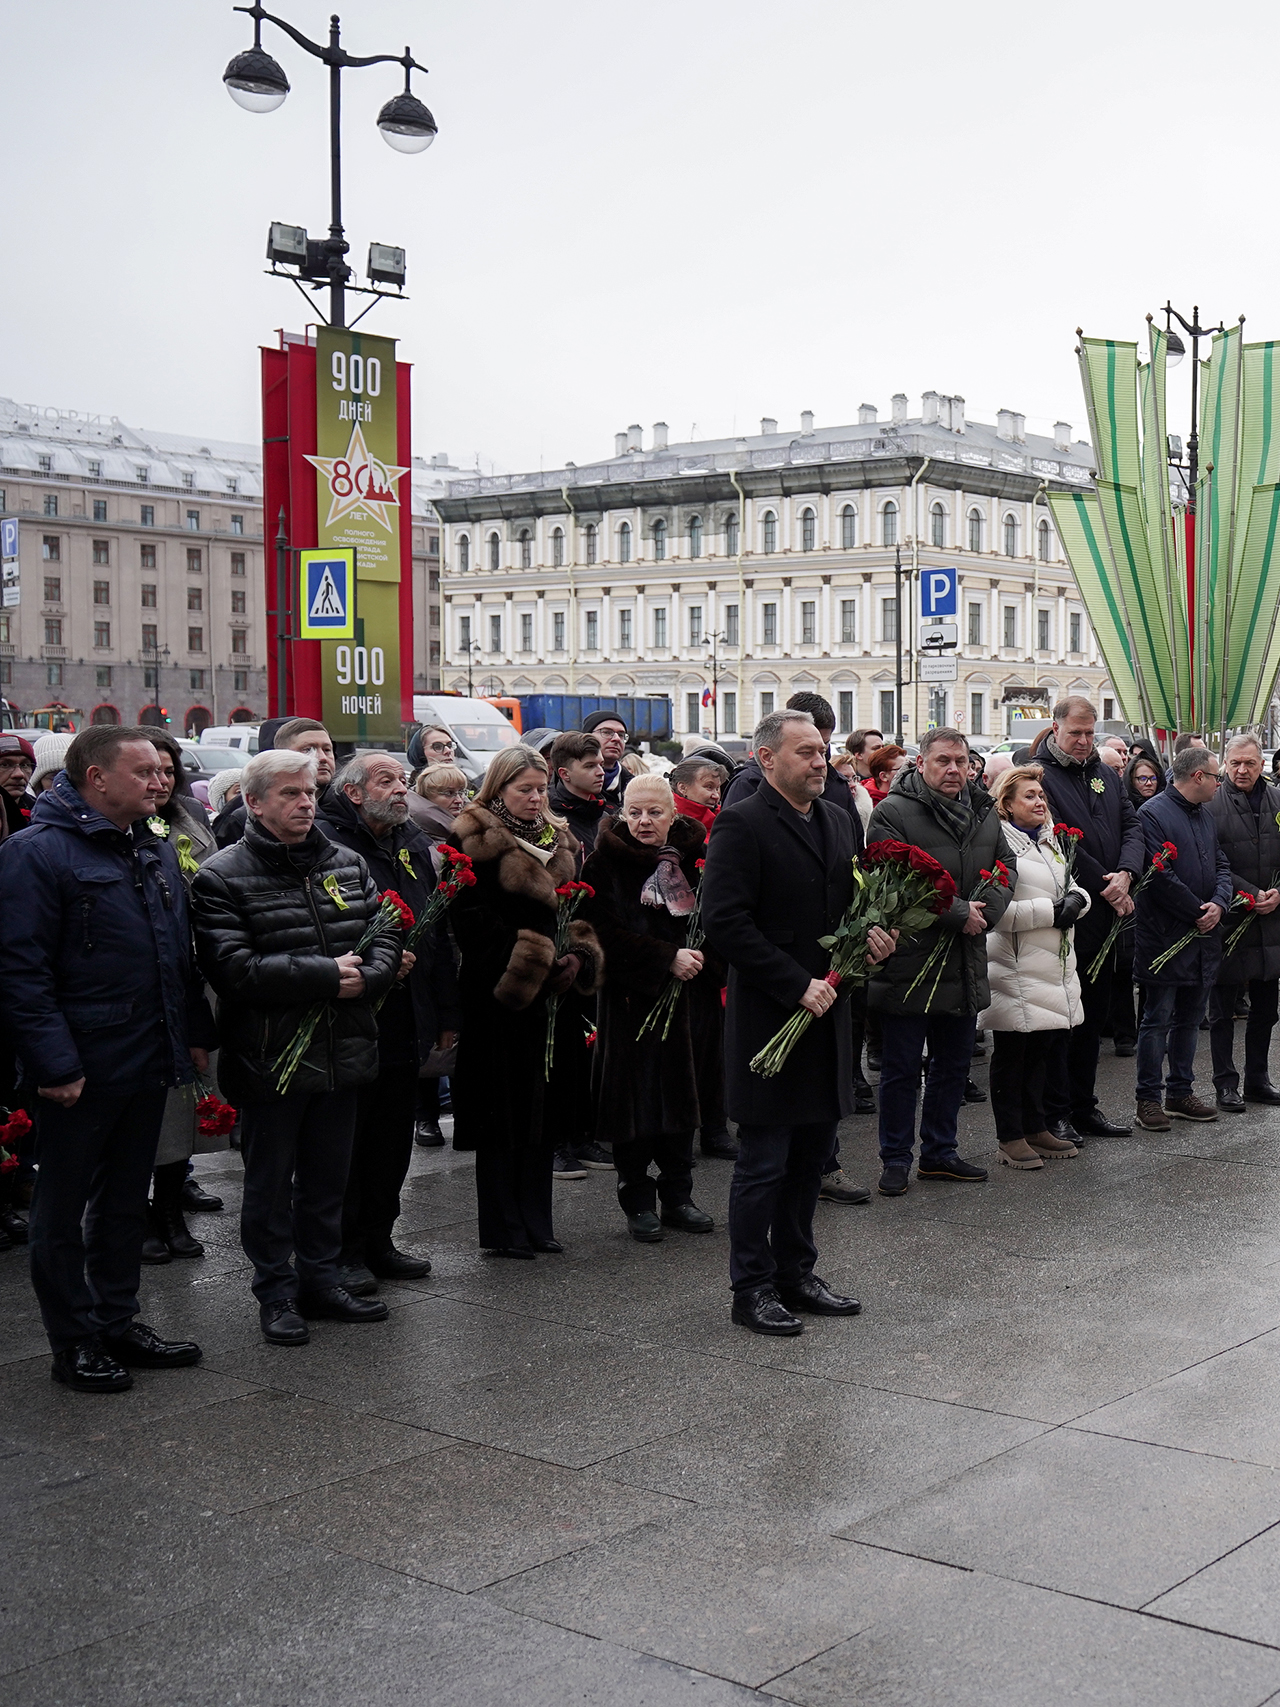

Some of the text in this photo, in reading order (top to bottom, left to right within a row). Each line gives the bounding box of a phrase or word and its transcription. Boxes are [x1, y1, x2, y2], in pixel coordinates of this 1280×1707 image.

[332, 351, 381, 397] 900
[338, 400, 372, 422] ДНЕЙ
[331, 460, 388, 498] 80
[349, 511, 368, 521] ЛЕТ
[332, 535, 387, 546] ОСВОБОЖДЕНИЯ
[344, 529, 375, 538] ПОЛНОГО
[356, 553, 388, 561] ИСТСКОЙ
[929, 573, 951, 612] P
[336, 645, 385, 686] 900
[342, 693, 382, 715] НОЧЕЙ
